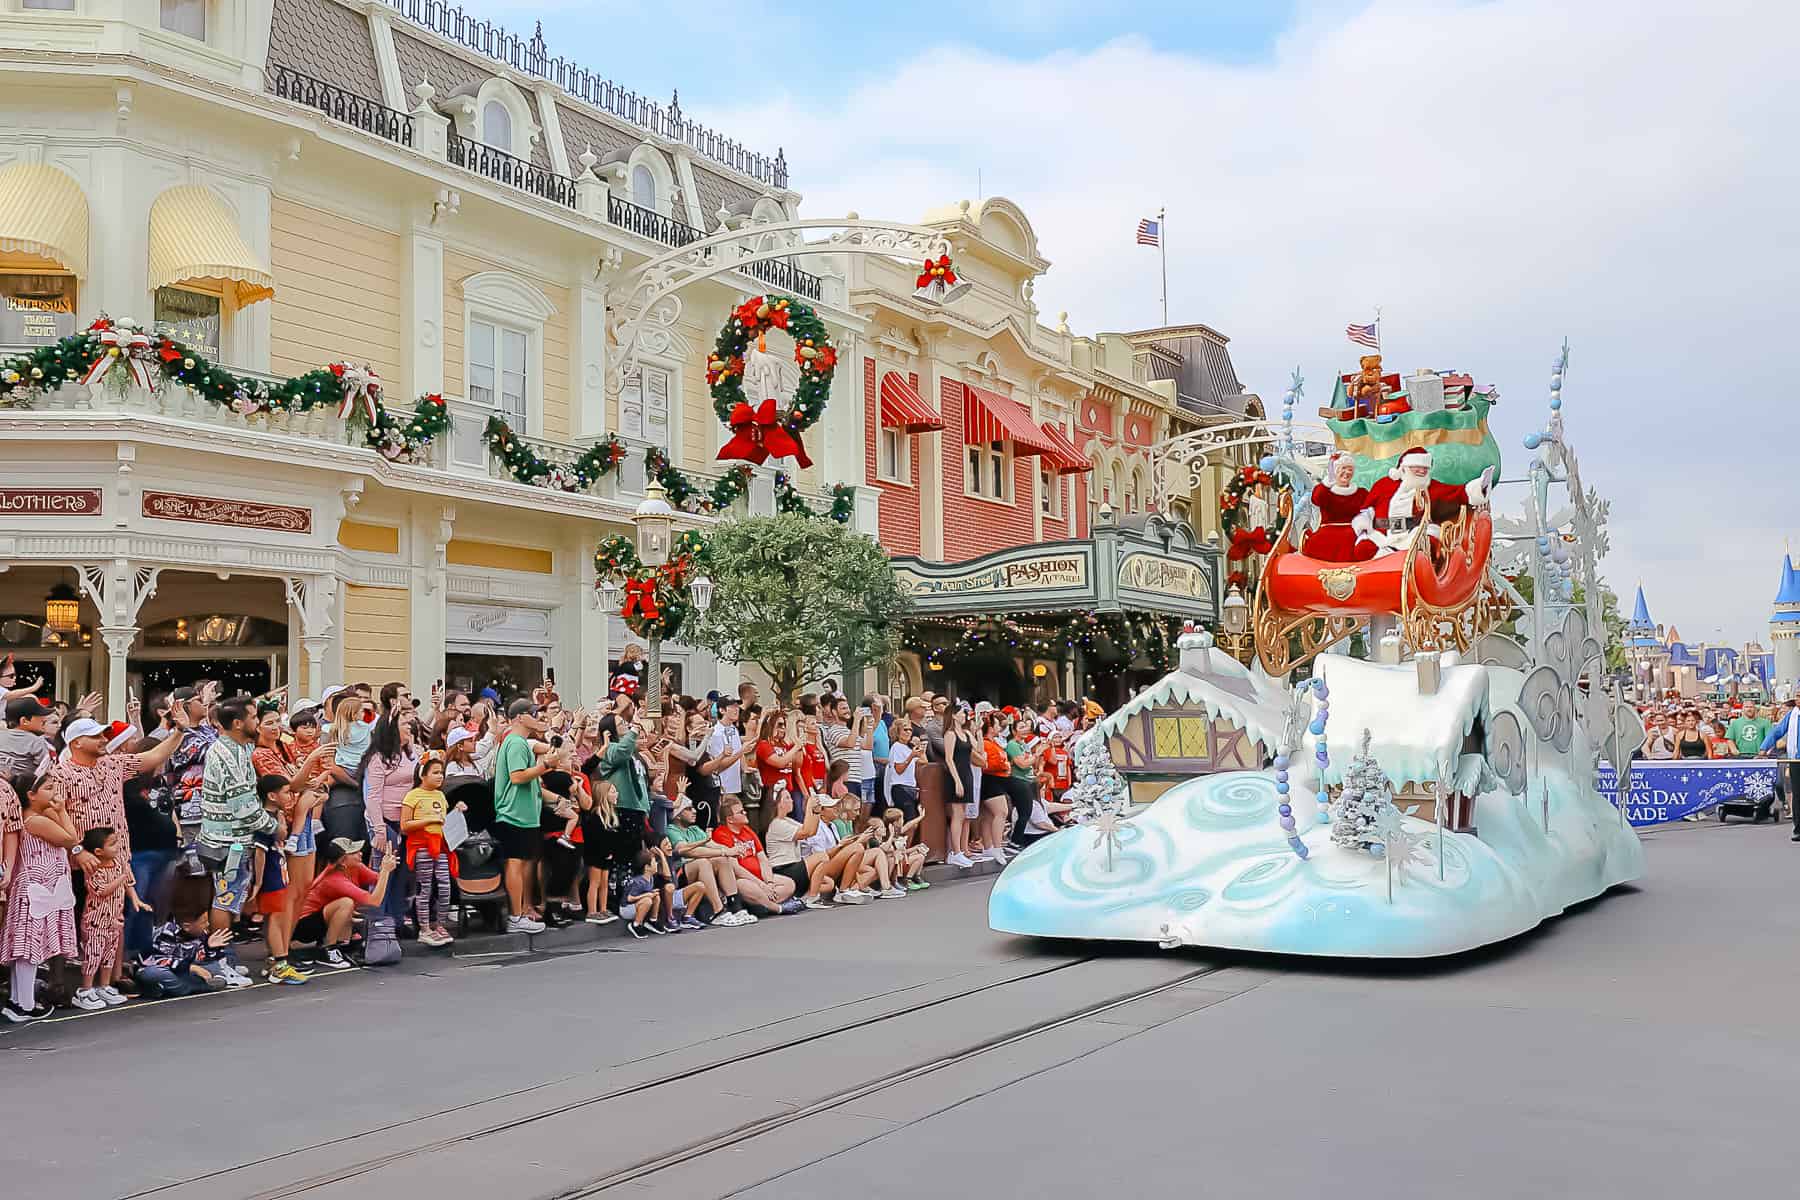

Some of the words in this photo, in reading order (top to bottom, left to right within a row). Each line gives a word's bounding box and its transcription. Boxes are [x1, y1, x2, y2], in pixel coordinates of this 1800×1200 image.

[0, 493, 87, 511] LOTHIERS
[1005, 559, 1080, 588] FASHION
[1652, 790, 1688, 805] DAY
